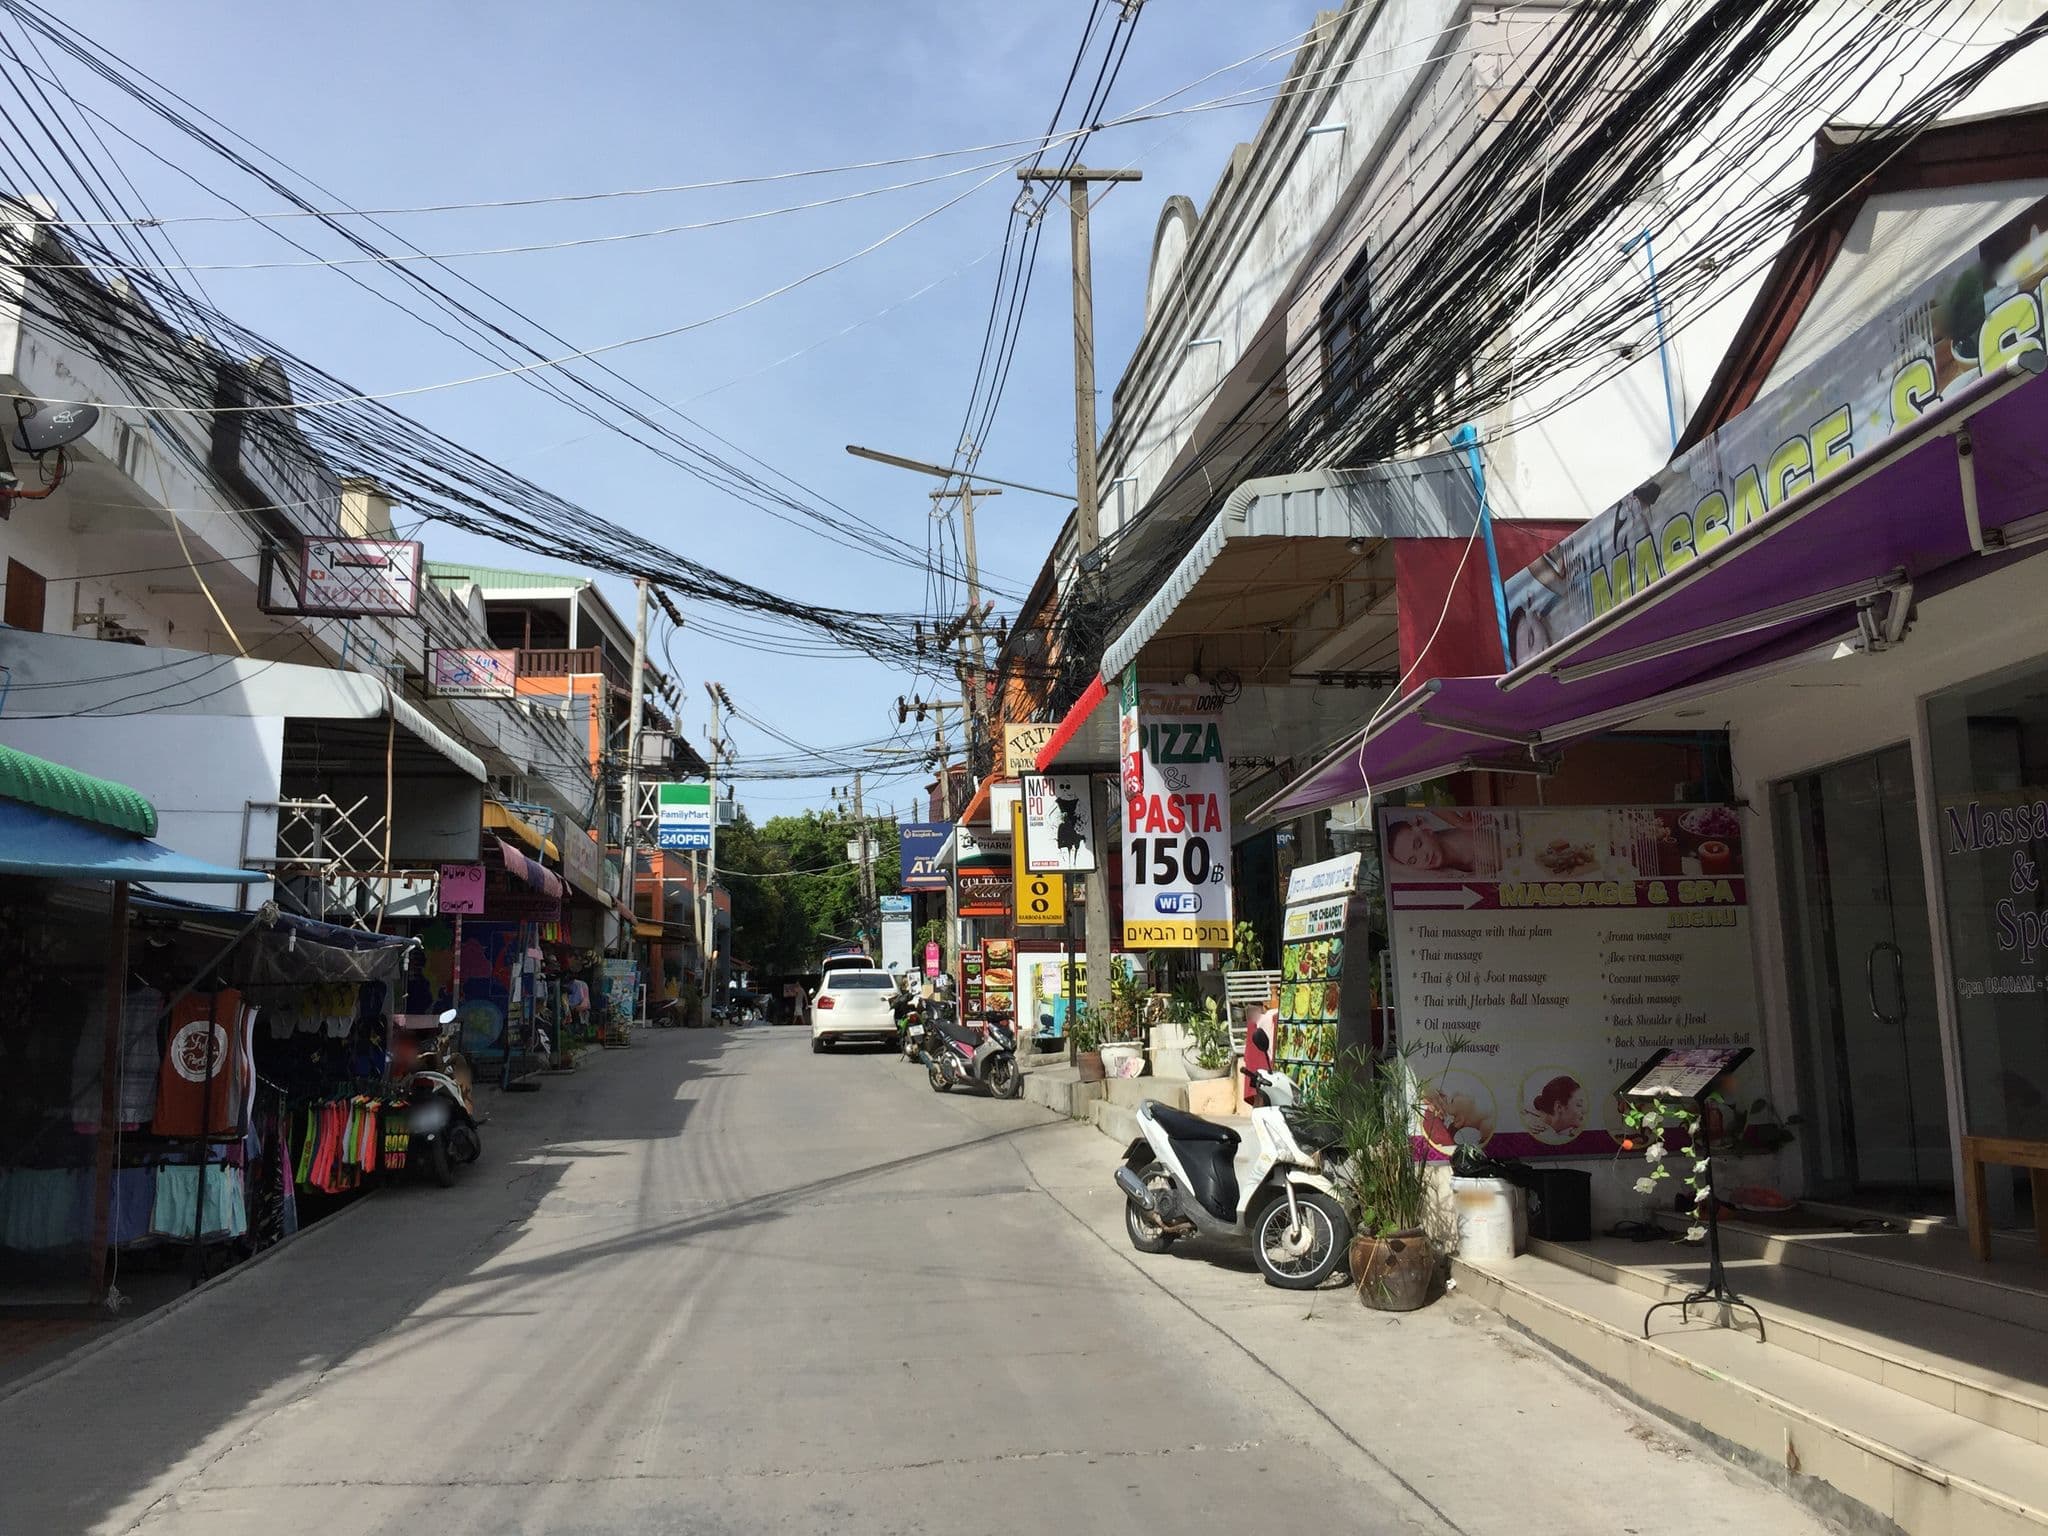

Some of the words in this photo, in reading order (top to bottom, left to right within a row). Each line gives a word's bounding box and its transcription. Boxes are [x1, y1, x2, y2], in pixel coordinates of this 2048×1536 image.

[1590, 402, 1853, 619] MASSAGE
[1009, 727, 1058, 752] TATT
[1164, 767, 1190, 791] &
[1028, 778, 1056, 797] NAPO
[1029, 797, 1043, 815] PO
[1128, 793, 1222, 833] PASTA
[661, 810, 709, 820] FamilyMart
[978, 841, 1012, 849] PHARM
[911, 860, 946, 874] AT
[2010, 850, 2039, 894] &
[1499, 881, 1638, 907] MASSAGE
[1647, 880, 1669, 904] &
[1677, 879, 1736, 903] SPA
[1128, 927, 1176, 941] הבאים
[1183, 927, 1229, 941] ברוכים
[1419, 926, 1439, 938] Thai
[1485, 926, 1504, 937] with
[1508, 925, 1526, 937] thai
[1637, 931, 1671, 944] massage
[1421, 949, 1442, 961] Thai
[1444, 952, 1482, 964] massage
[1648, 953, 1682, 965] massage
[1421, 971, 1442, 984] Thai
[1456, 971, 1470, 983] Oil
[1508, 974, 1547, 985] massage
[1608, 974, 1641, 984] Coconut
[1644, 974, 1680, 986] massage
[1957, 977, 1984, 999] Open
[1423, 995, 1444, 1007] Thai
[1447, 995, 1467, 1006] with
[1467, 994, 1506, 1010] Herbals
[1510, 993, 1528, 1005] Ball
[1610, 994, 1643, 1006] Swedish
[1647, 994, 1681, 1007] massage
[1424, 1018, 1439, 1030] Oil
[1442, 1021, 1481, 1033] massage
